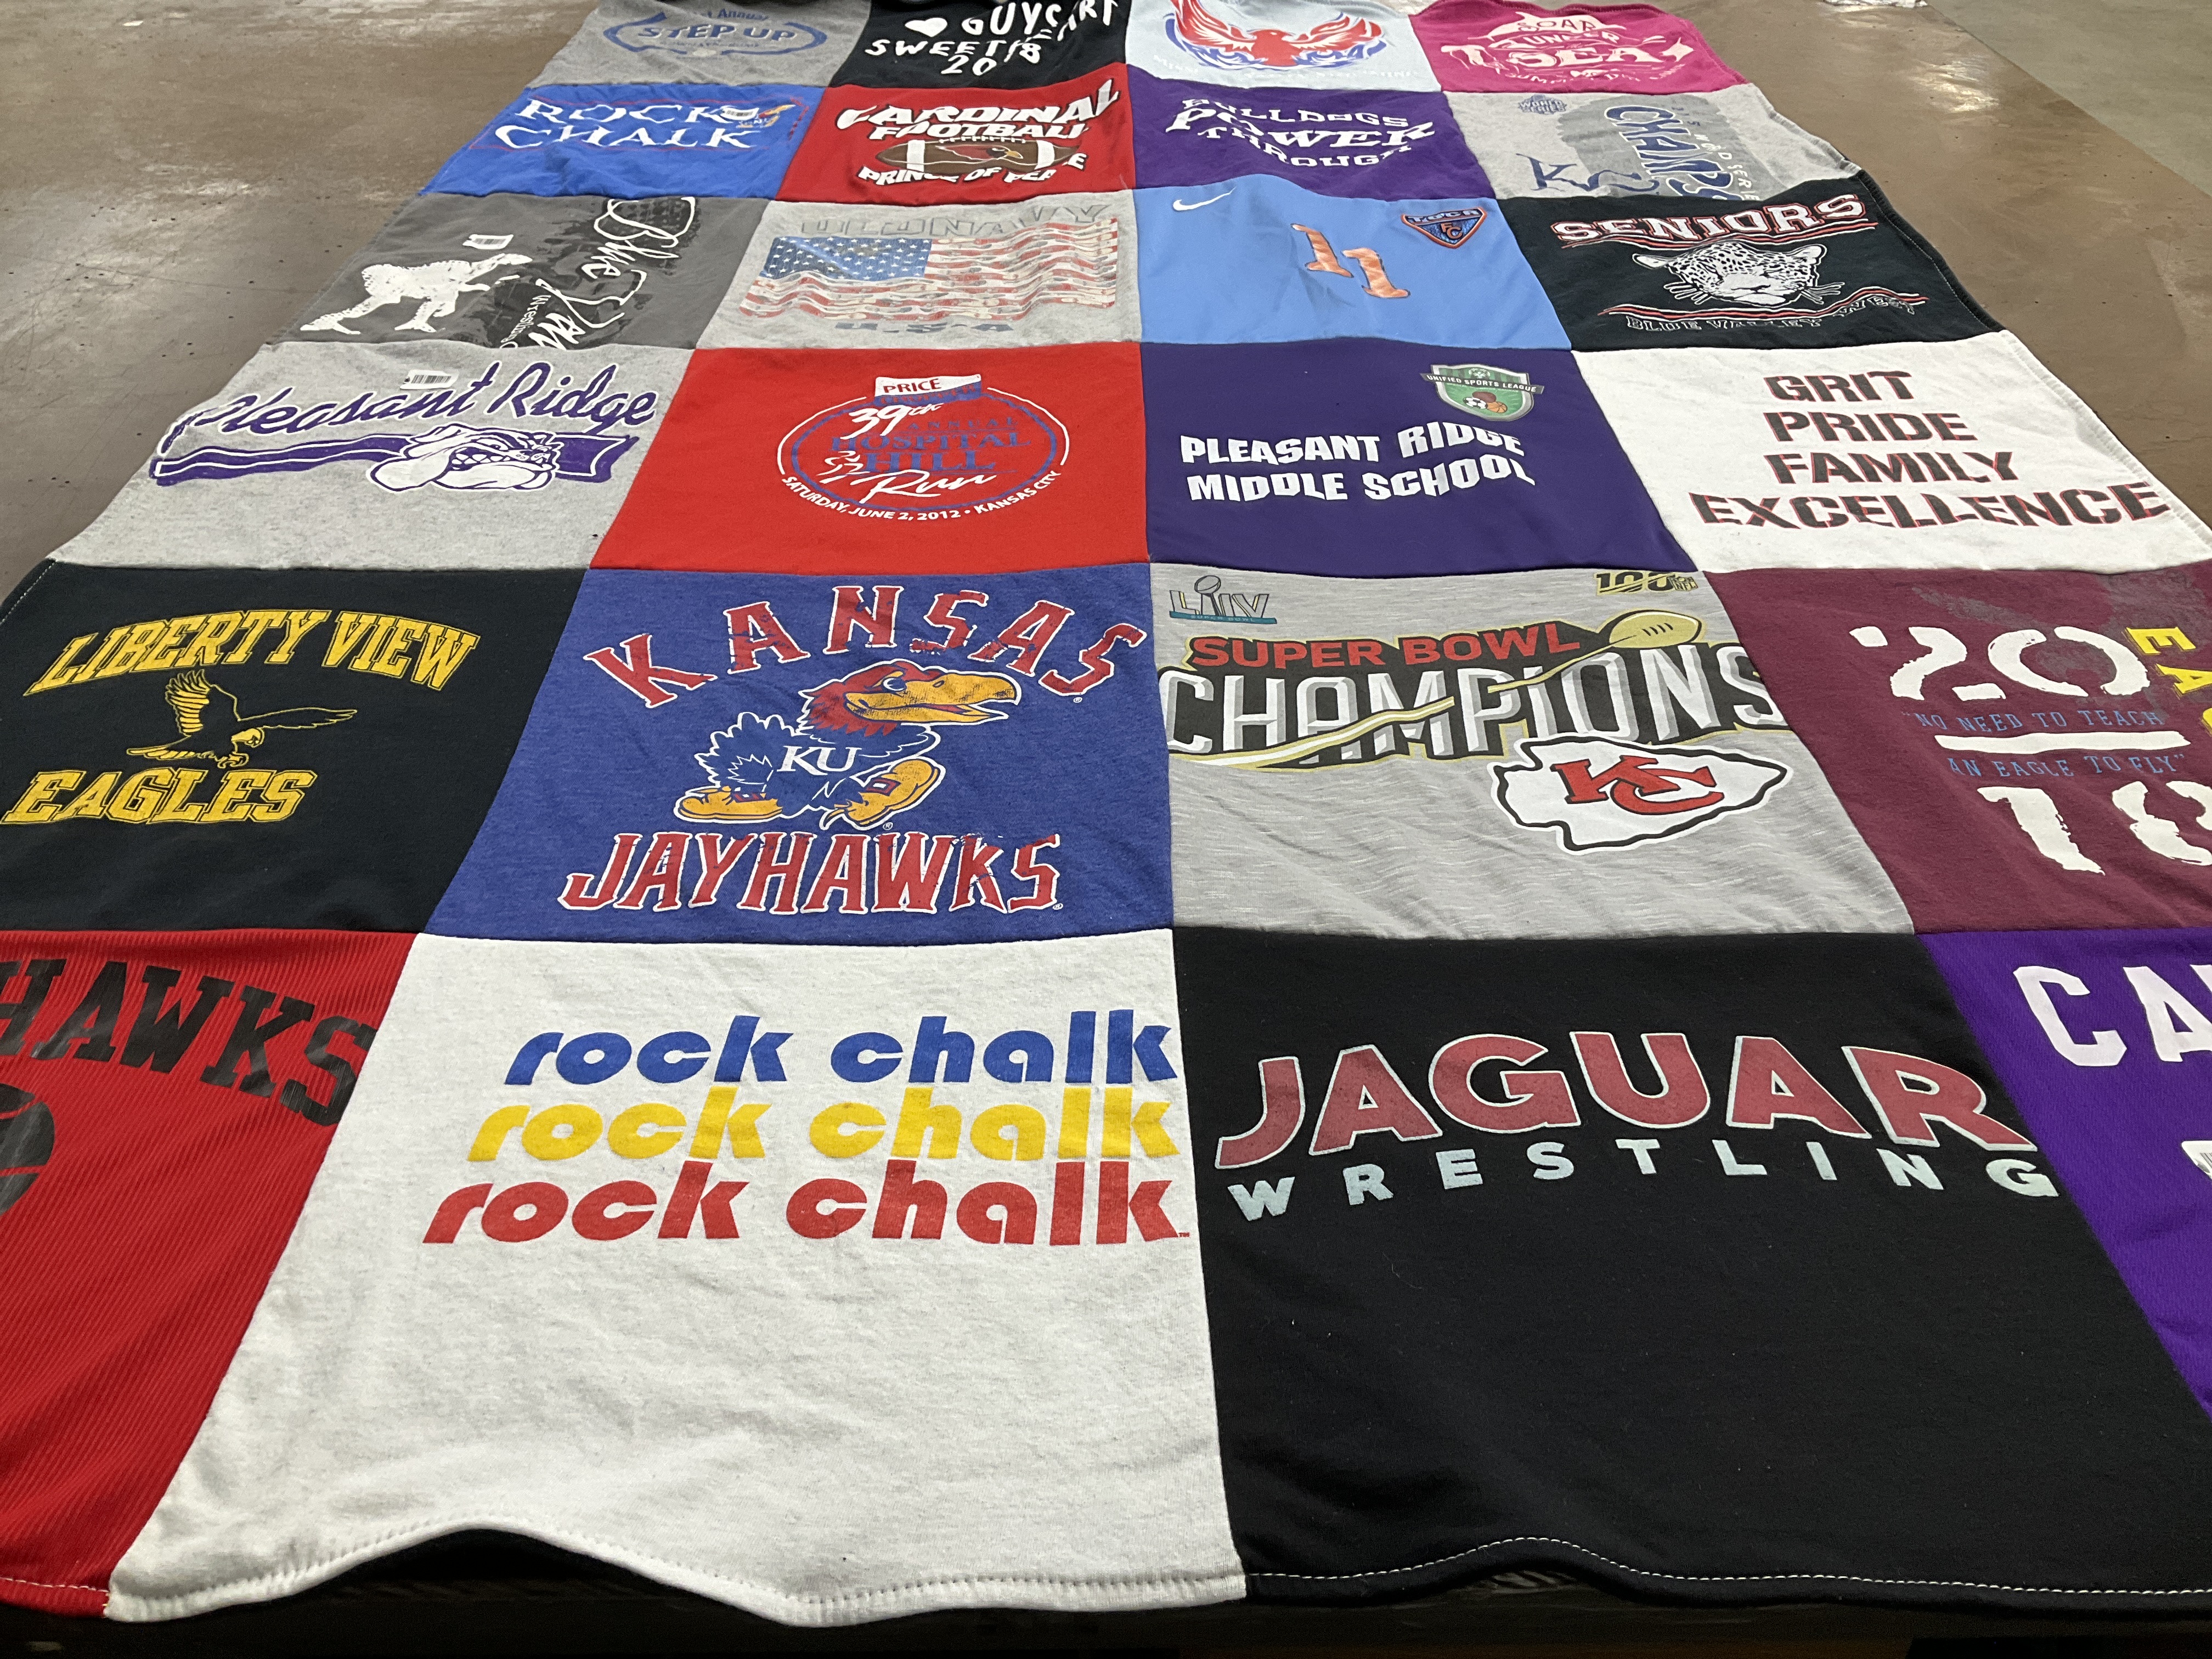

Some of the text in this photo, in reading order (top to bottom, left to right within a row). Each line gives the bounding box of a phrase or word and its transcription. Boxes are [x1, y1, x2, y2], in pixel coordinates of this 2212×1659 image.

[638, 24, 798, 41] STEP UP
[514, 99, 732, 123] ROCK
[836, 78, 1120, 129] CARDINAL
[1182, 99, 1409, 127] BULLDOGS
[495, 125, 761, 149] CHALK
[869, 121, 1090, 140] FOOTBALL
[1165, 108, 1436, 148] POWER
[857, 153, 1087, 187] PRIN OF PEAE
[801, 204, 1111, 236] OLD NAVY
[1440, 222, 1463, 239] FC
[1551, 194, 1867, 241] SENIORS
[882, 379, 943, 393] PRICE
[1426, 375, 1463, 384] UNIFIED
[1464, 379, 1499, 387] SPORTS
[1502, 382, 1537, 393] LEAGUE
[1763, 370, 1915, 402] GRIT
[158, 361, 659, 454] Pleasant Ridge
[907, 417, 1019, 429] ANNUAL
[1762, 411, 1979, 442] PRIDE
[832, 432, 1031, 452] HOSPITAL
[863, 450, 996, 473] HILL
[1180, 421, 1525, 466] PLEASANT RIDGE
[850, 469, 997, 504] Run
[1186, 454, 1536, 502] MIDDLE SCHOOL
[1763, 451, 2019, 484] FAMILY
[782, 470, 1062, 522] SATURDAY, JUNE 2, 2012 KANSAS CITY
[1688, 481, 2171, 530] EXCELLENCE
[22, 610, 482, 697] LIBERTY VIEW
[583, 585, 1148, 709] KANSAS
[1192, 620, 1582, 669] SUPER BOWL
[1160, 642, 1786, 764] CHAMPIONS
[1956, 712, 2023, 733] NEED
[2033, 712, 2068, 728] TO
[2077, 710, 2167, 727] TEACH
[776, 744, 860, 775] KU
[1947, 757, 1983, 777] AN
[1991, 759, 2075, 778] EAGLE
[2085, 754, 2122, 774] TO
[0, 767, 318, 825] EAGLES
[1550, 755, 1726, 815] KC
[557, 831, 1063, 914] JAYHAWKS
[2013, 964, 2212, 1066] CA
[504, 1009, 1179, 1086] rock chalk
[1215, 1031, 2039, 1170] JAGUAR
[466, 1084, 1181, 1162] rock chalk
[1227, 1137, 2059, 1222] WRESTLING
[422, 1158, 1179, 1246] rock chalk
